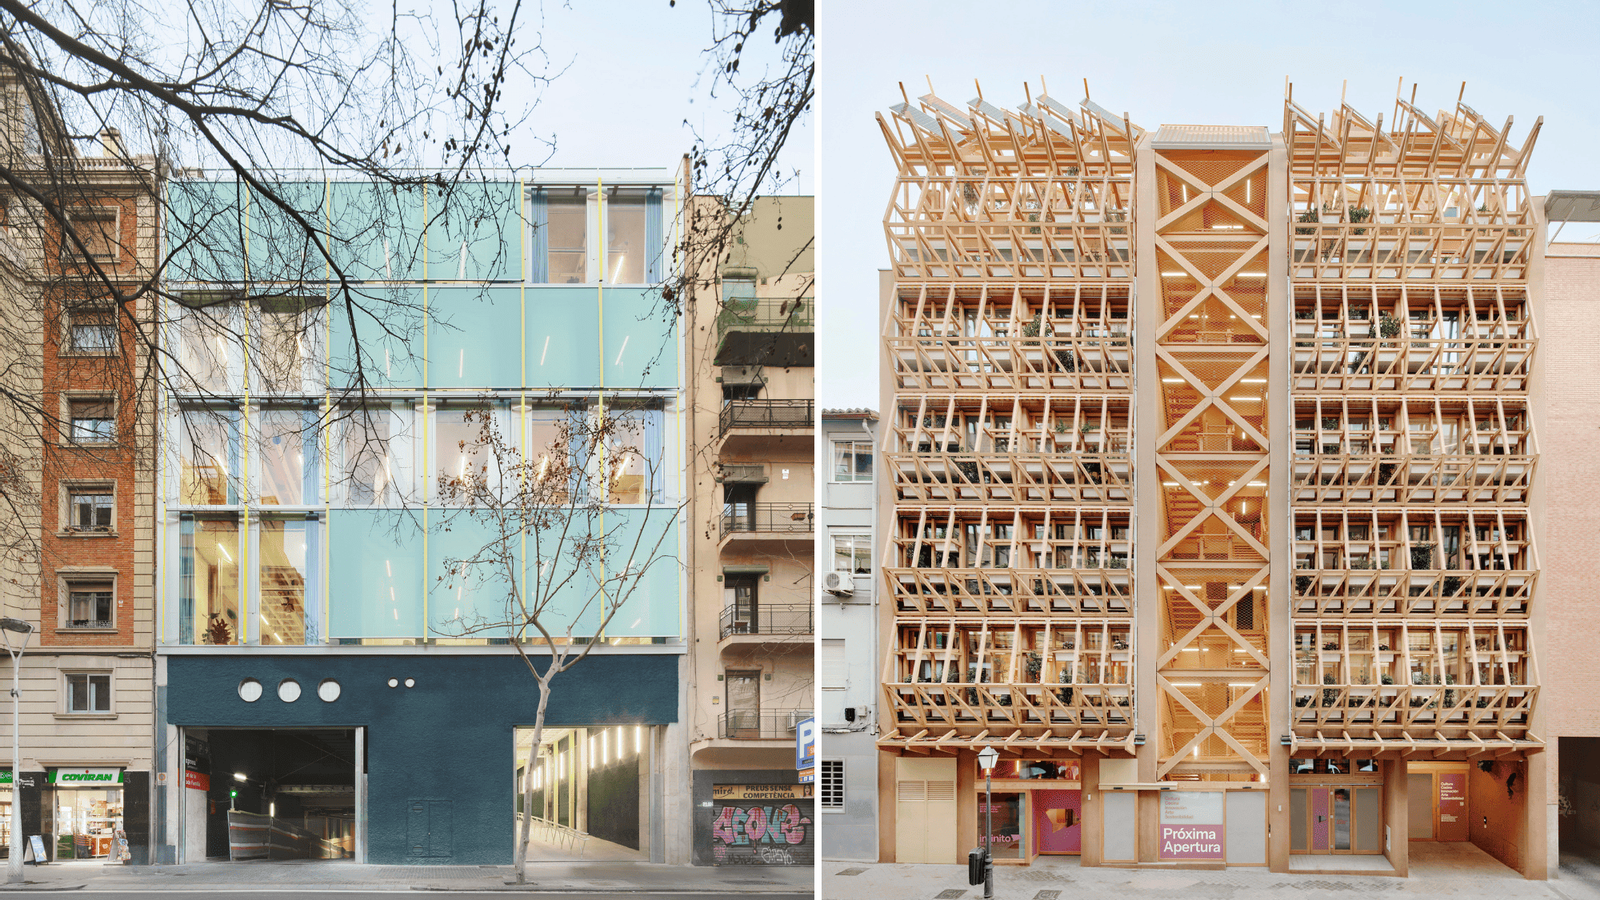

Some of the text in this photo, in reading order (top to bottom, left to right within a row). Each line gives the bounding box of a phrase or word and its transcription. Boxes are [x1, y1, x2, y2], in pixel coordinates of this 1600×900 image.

[800, 721, 814, 758] P
[980, 834, 1011, 842] ininito
[1164, 828, 1216, 839] Próxima
[1164, 841, 1220, 855] Apertura
